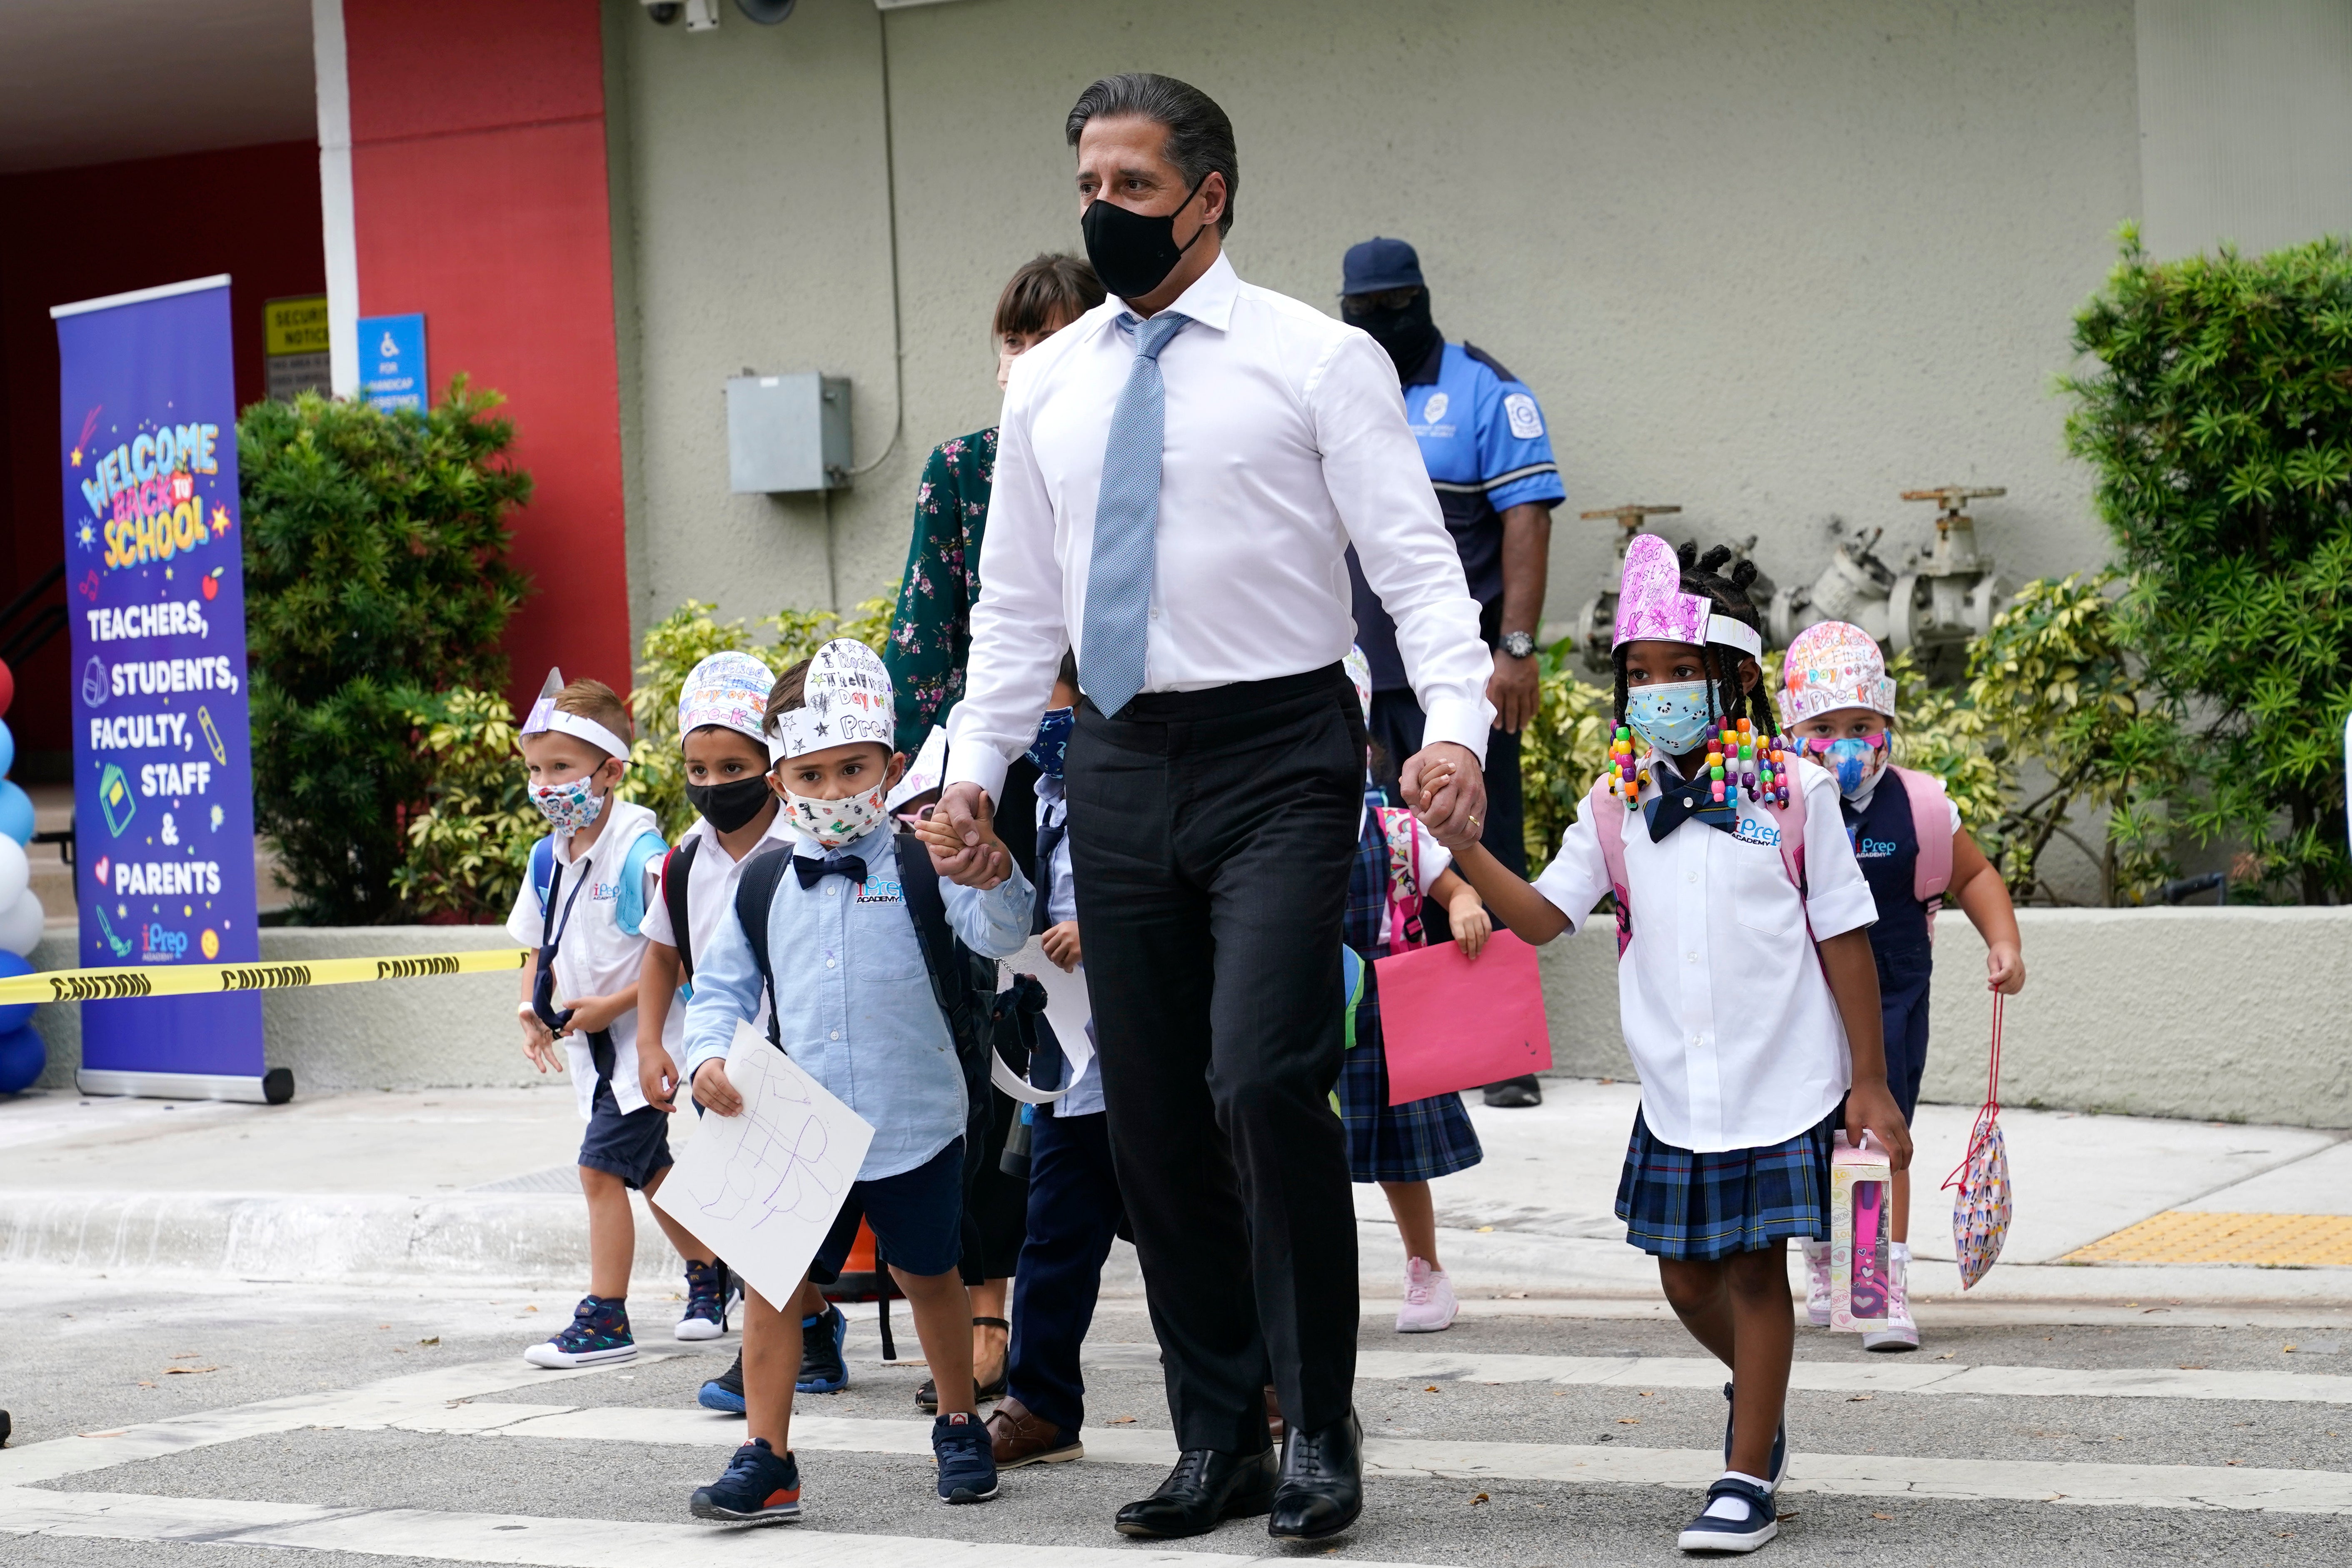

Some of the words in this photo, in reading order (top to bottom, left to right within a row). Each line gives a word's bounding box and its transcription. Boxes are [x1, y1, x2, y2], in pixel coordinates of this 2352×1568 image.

[81, 422, 219, 519] WELCOME
[113, 474, 172, 527] BACK
[172, 477, 193, 499] TO
[104, 495, 210, 570] SCHOOL
[87, 599, 209, 642] TEACHERS,
[1813, 633, 1866, 649] Rocked
[112, 655, 239, 697] STUDENTS,
[709, 662, 765, 679] Rocked
[821, 652, 834, 668] I
[838, 652, 883, 675] Rocked
[1809, 668, 1838, 684] Day
[695, 689, 722, 703] Day
[728, 690, 747, 701] of
[838, 689, 869, 714] Day
[1810, 684, 1870, 712] Pre-K
[688, 708, 748, 729] Pre-K
[90, 712, 193, 752] FACULTY,
[141, 761, 211, 797] STAFF
[161, 812, 180, 846] &
[1732, 833, 1770, 846] ACADEMY
[1856, 838, 1896, 856] iPrep
[115, 861, 221, 895] PARENTS
[594, 884, 619, 898] iPep
[142, 923, 188, 959] iPrep
[221, 965, 311, 991] CAUTION
[377, 956, 459, 979] CAUTION
[50, 974, 151, 1001] CAUTION
